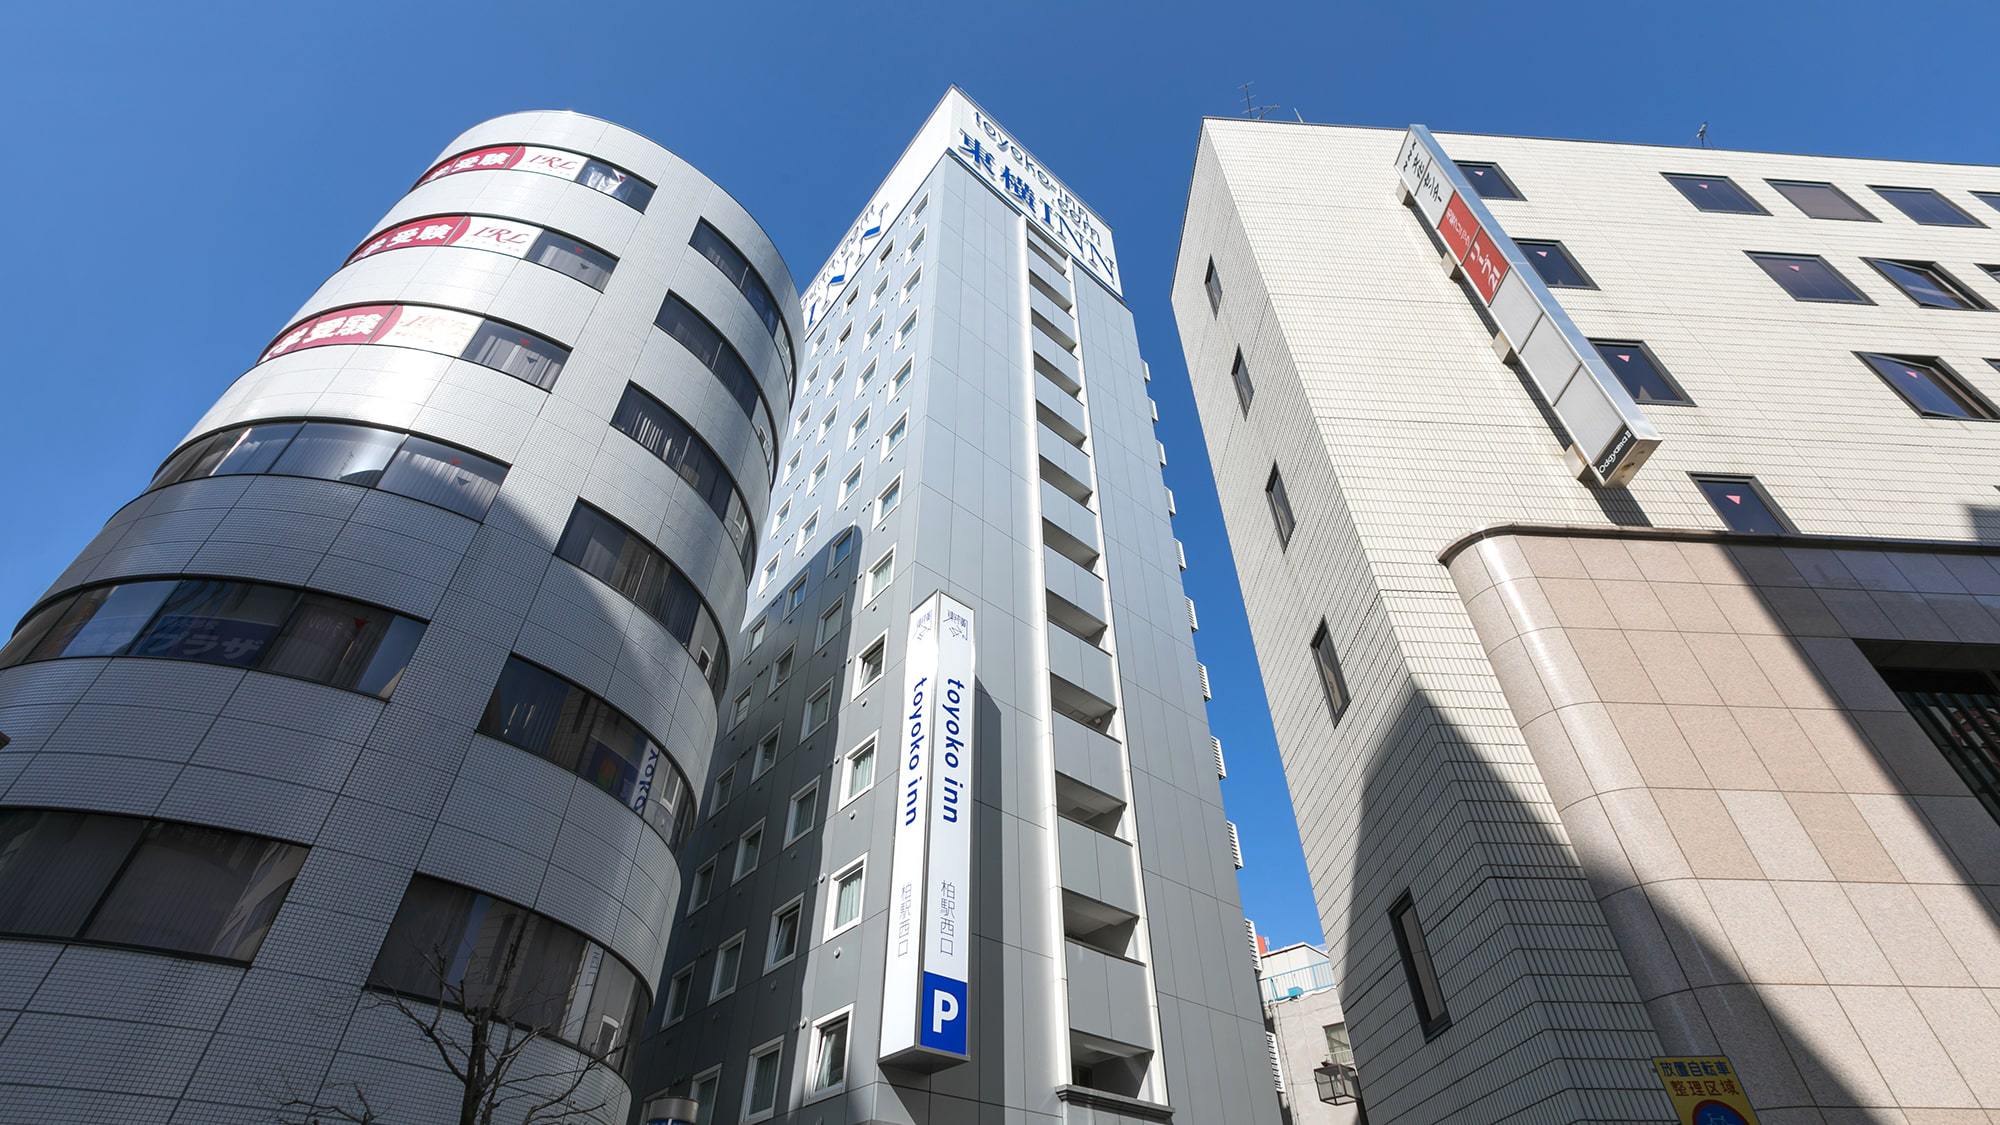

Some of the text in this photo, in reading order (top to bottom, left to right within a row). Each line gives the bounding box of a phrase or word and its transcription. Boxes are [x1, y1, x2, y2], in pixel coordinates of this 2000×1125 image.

[958, 127, 1116, 286] 東横INN
[906, 677, 927, 826] toyoko inn
[943, 678, 966, 823] toyoko inn
[898, 882, 912, 958] 柏駅西口
[941, 879, 956, 956] 柏駅西口
[933, 989, 959, 1033] P
[1660, 1061, 1731, 1077] 放置自転車
[1670, 1079, 1740, 1097] 整理区域
